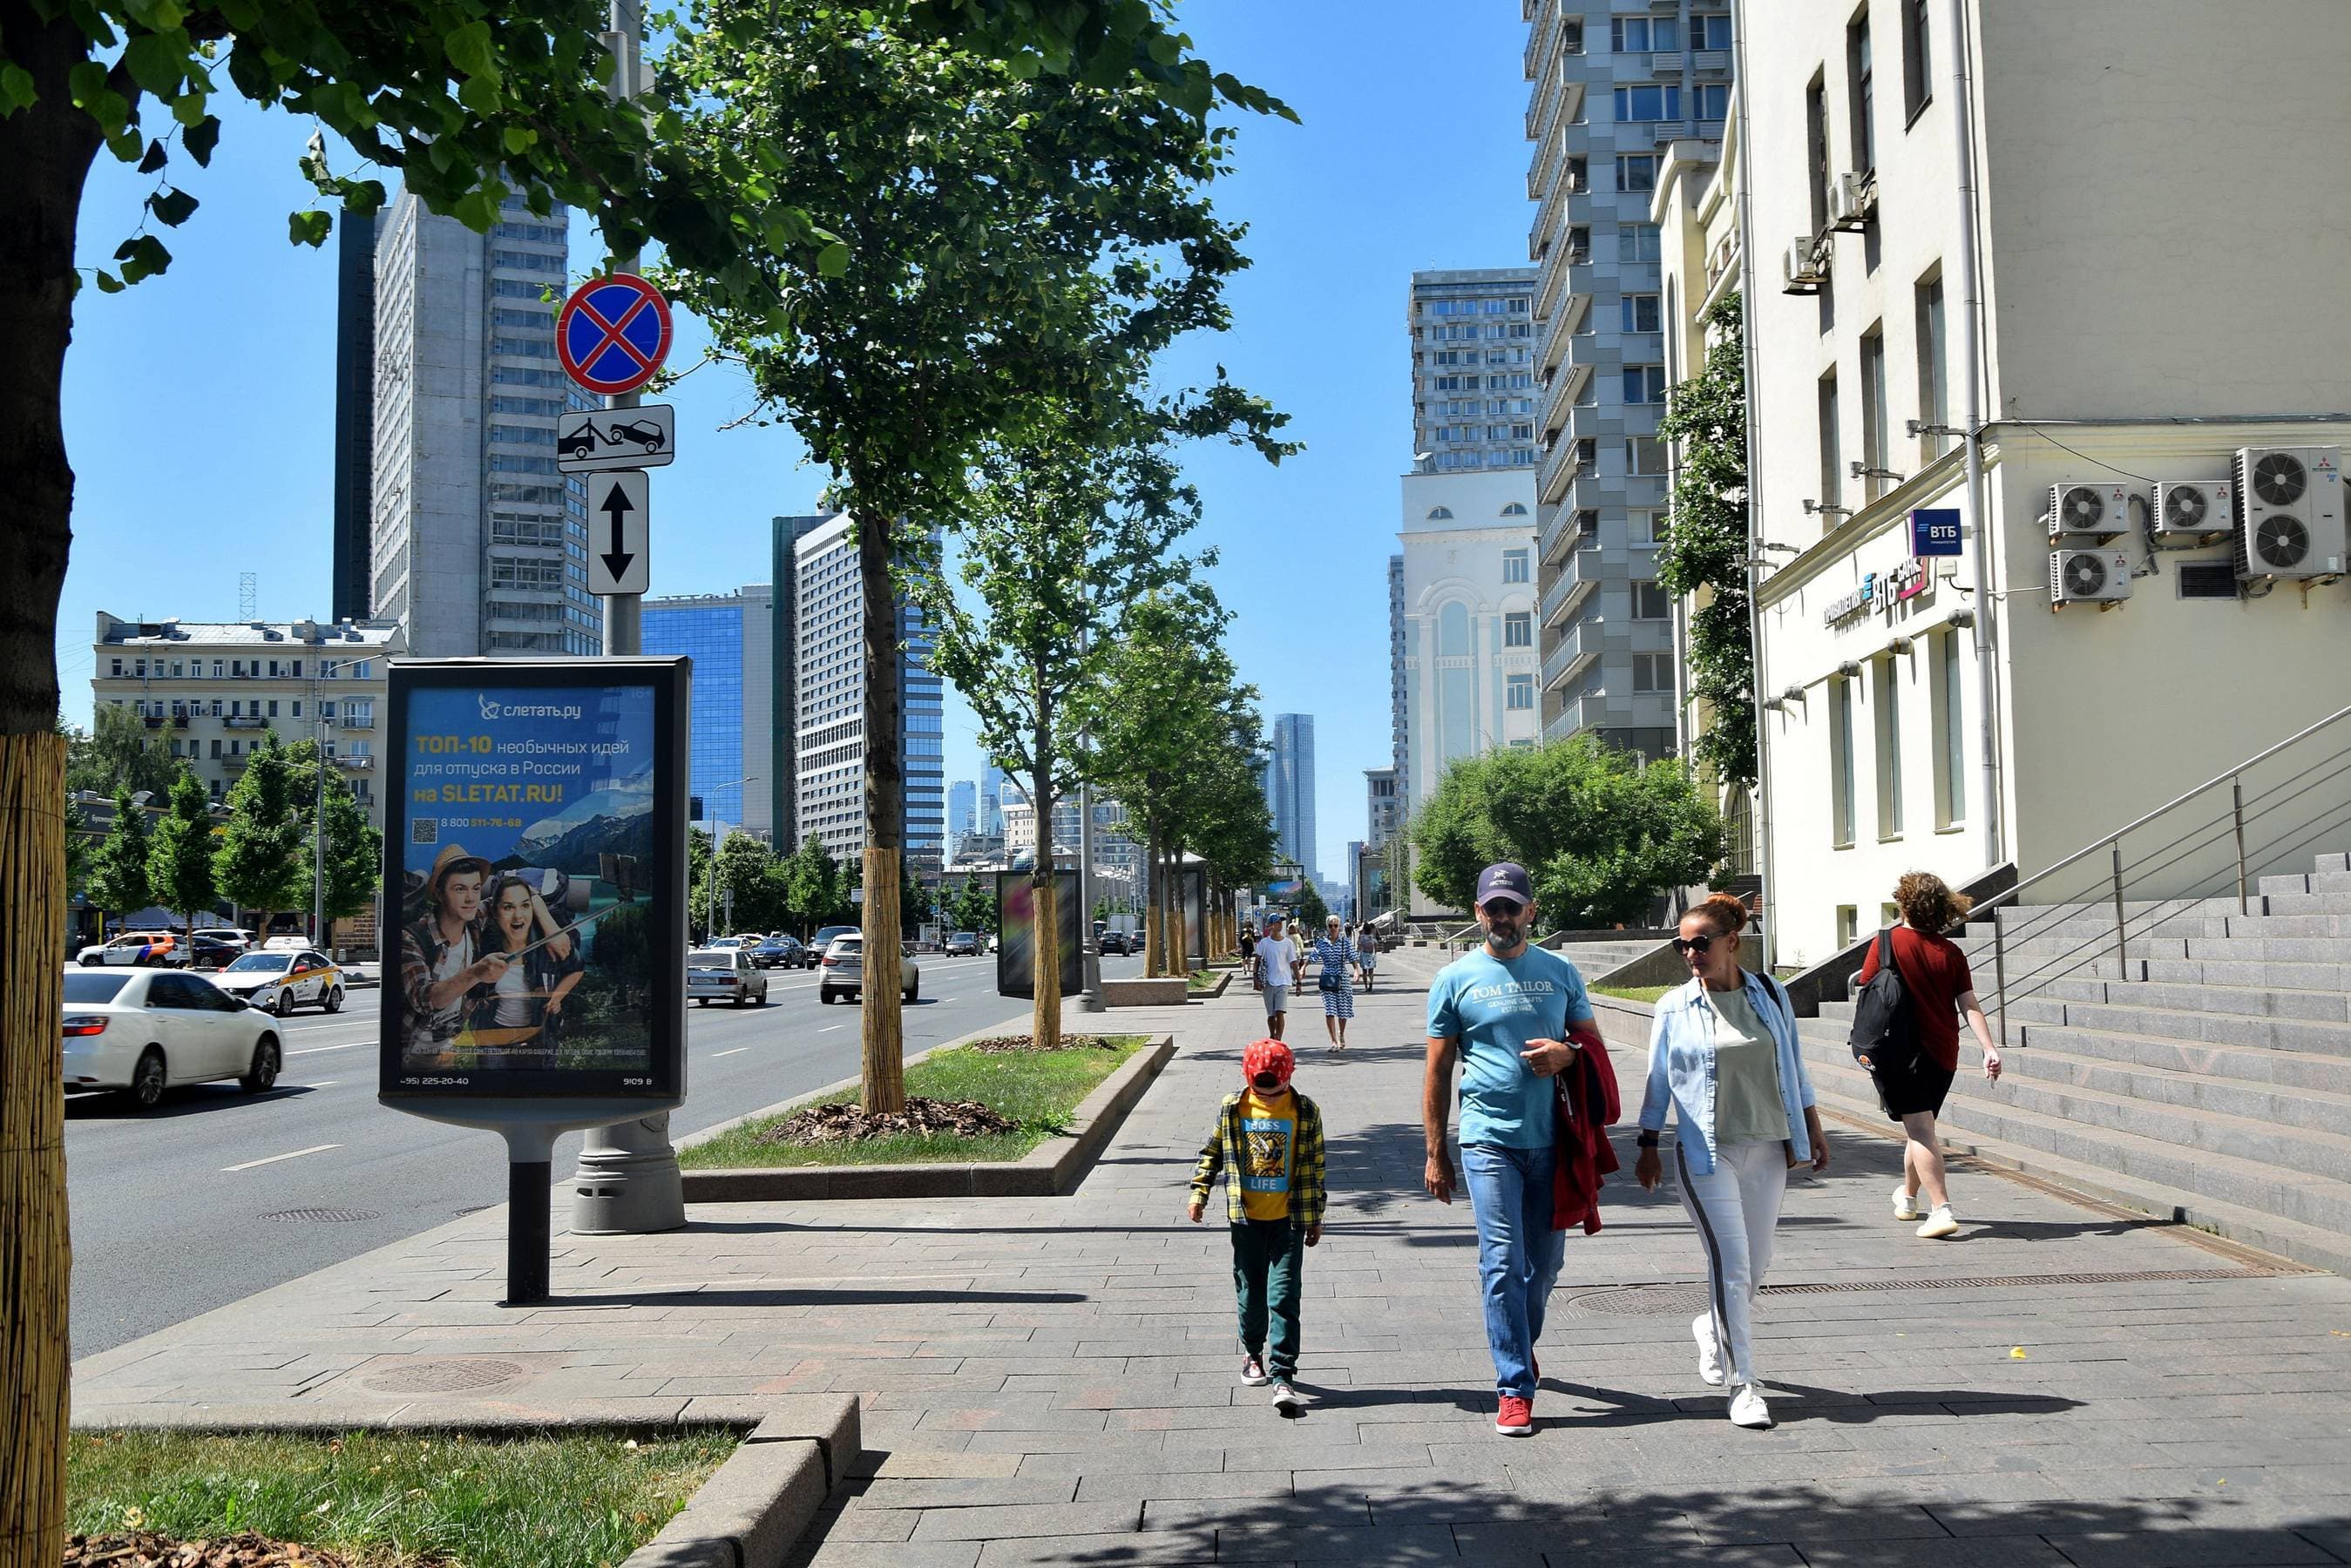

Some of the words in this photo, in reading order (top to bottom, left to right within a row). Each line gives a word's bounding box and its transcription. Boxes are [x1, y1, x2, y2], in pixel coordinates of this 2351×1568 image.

[1930, 525, 1957, 538] ВТБ
[1872, 571, 1900, 615] ВТБ
[1898, 558, 1922, 582] БАНК
[504, 706, 581, 720] слетать.ру
[416, 735, 492, 754] ТОП-10
[498, 740, 587, 754] необычных
[592, 740, 629, 756] идей
[414, 763, 443, 777] для
[445, 763, 507, 779] отпуска
[511, 764, 519, 774] в
[523, 760, 580, 774] России
[414, 789, 437, 802] на
[442, 784, 564, 803] SLETAT.RU!
[440, 818, 448, 828] 8
[450, 818, 470, 828] 800
[1471, 984, 1502, 1000] TOM
[1505, 981, 1554, 994] TAILOR
[422, 1077, 469, 1085] 225-20-40
[1250, 1120, 1280, 1131] BOSS
[1250, 1179, 1277, 1190] LIFE
